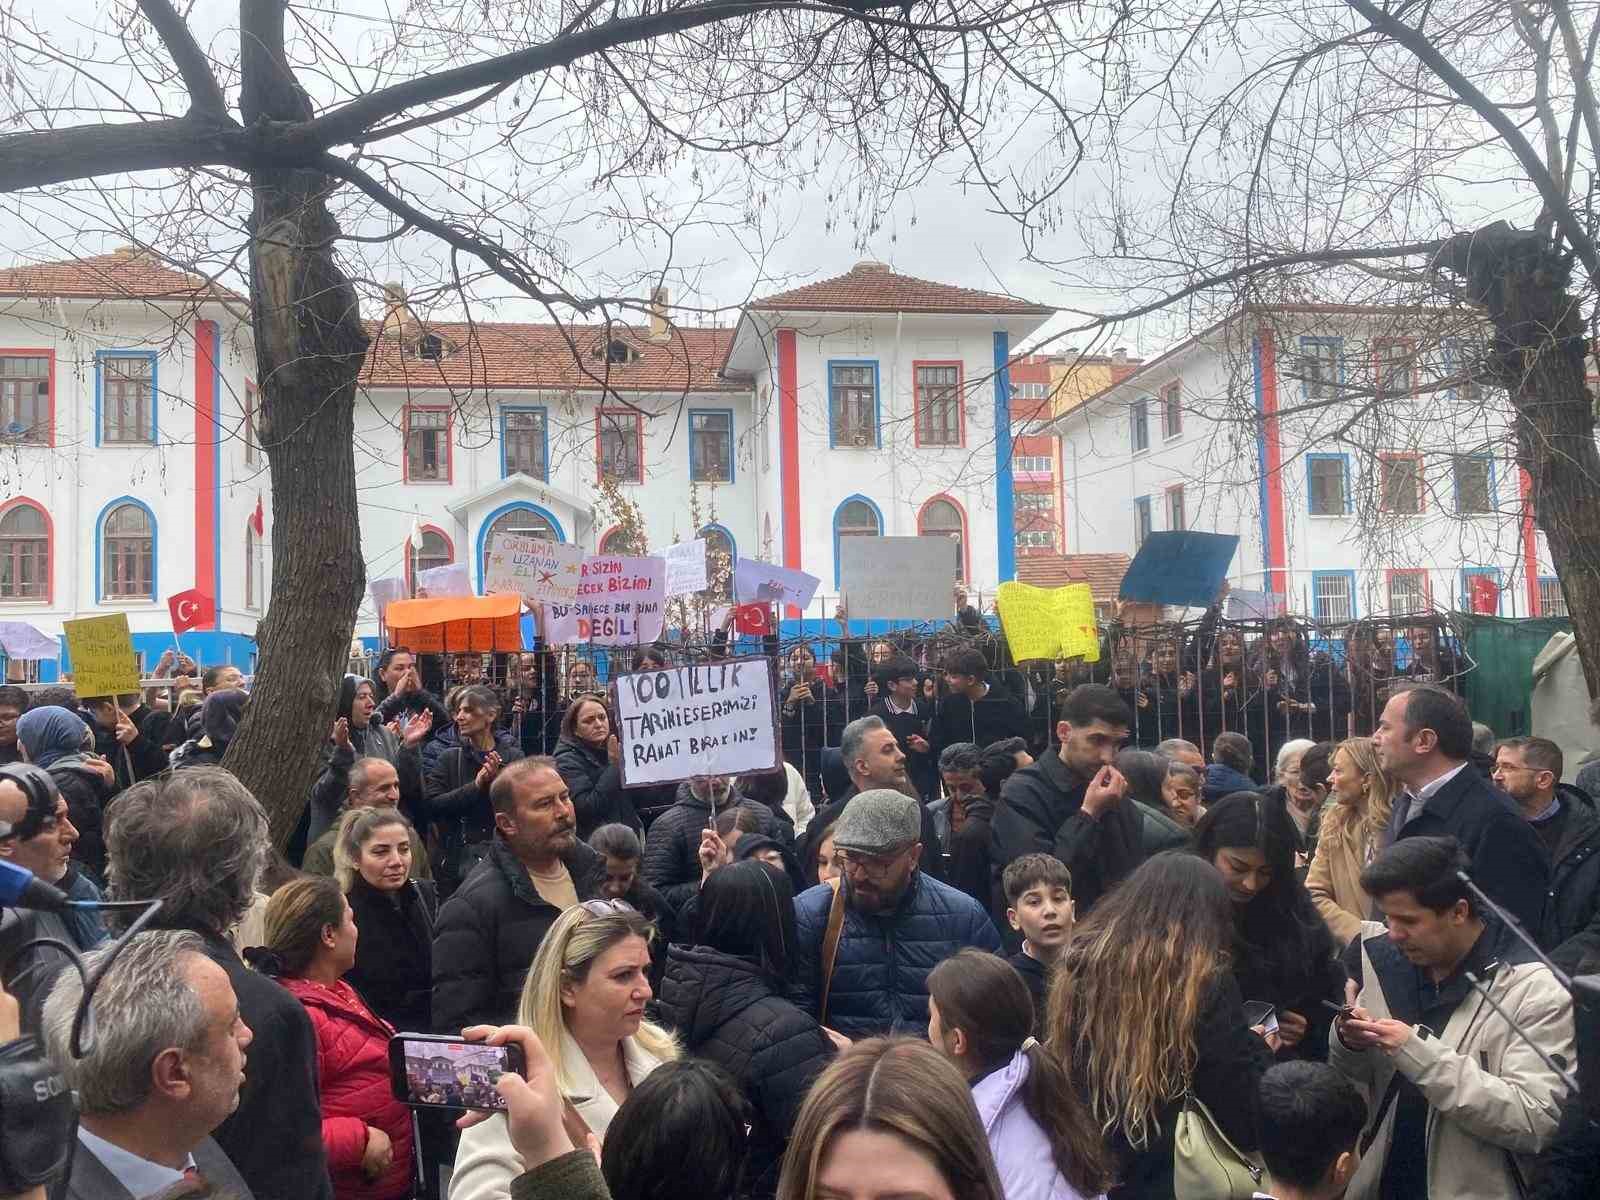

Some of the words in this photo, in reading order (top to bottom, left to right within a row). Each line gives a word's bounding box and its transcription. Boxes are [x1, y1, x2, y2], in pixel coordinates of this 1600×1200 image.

[577, 583, 604, 595] ECEK
[608, 574, 652, 592] BİZİM!
[626, 671, 670, 708] 100
